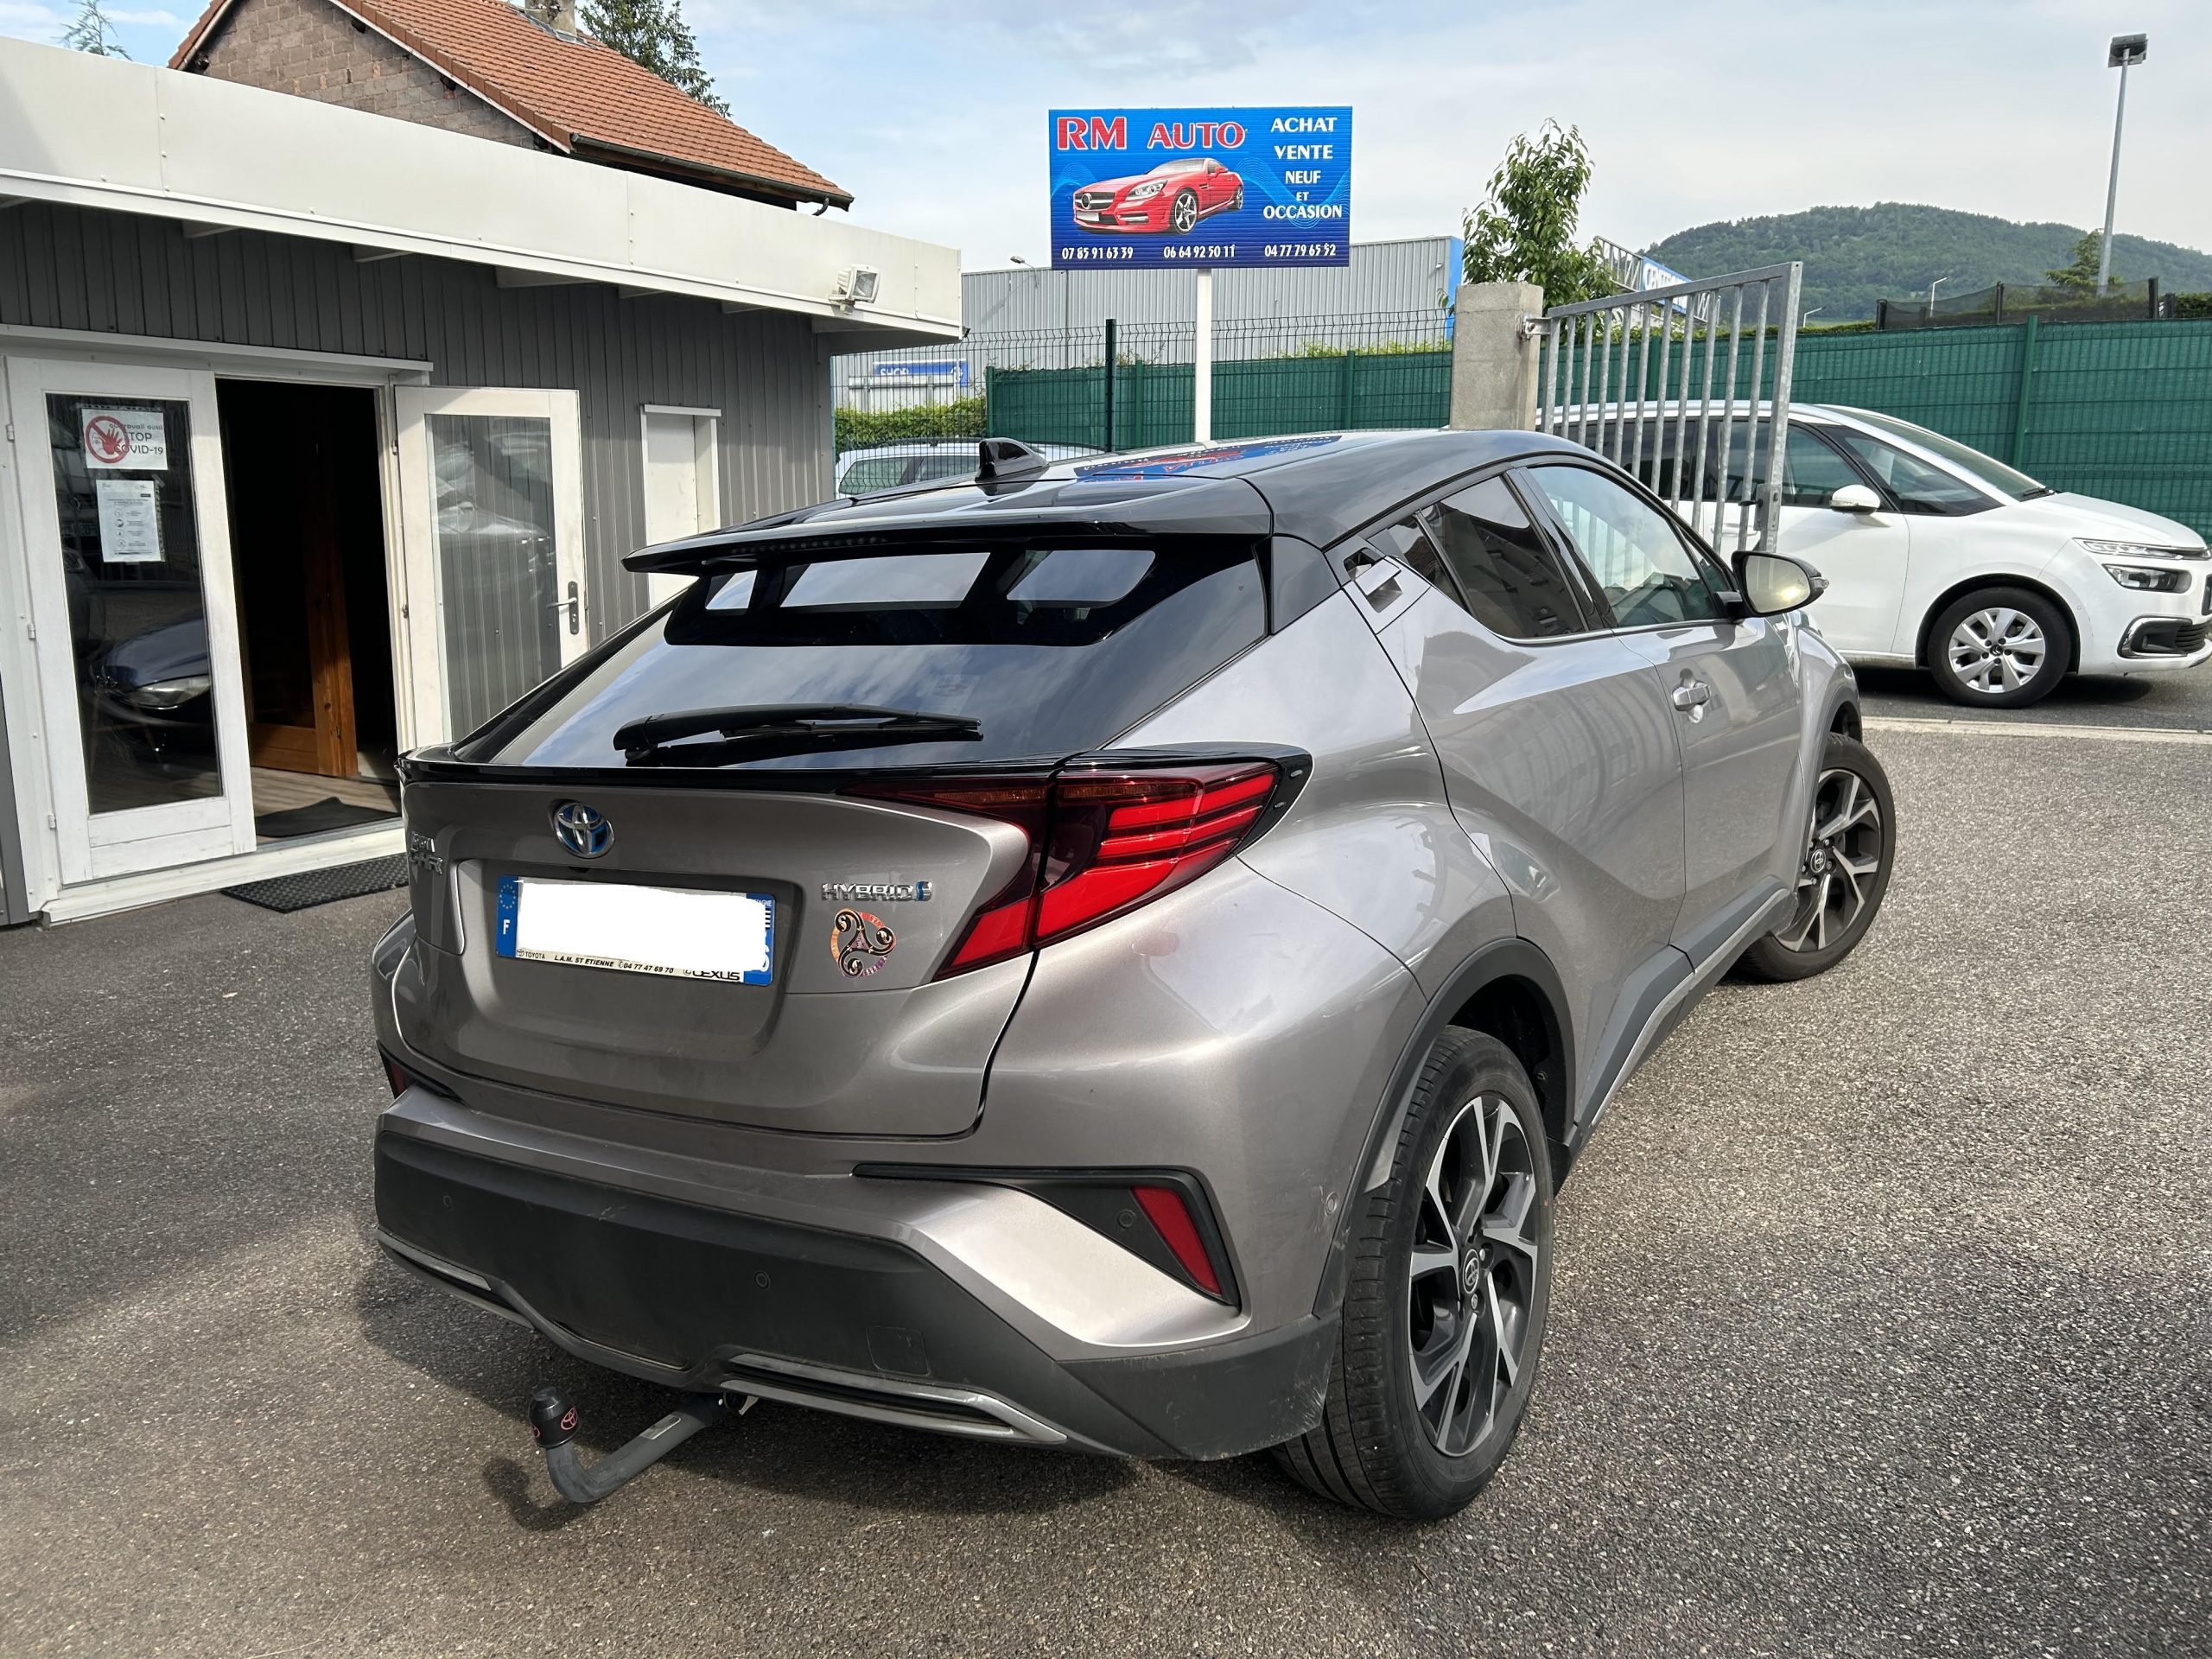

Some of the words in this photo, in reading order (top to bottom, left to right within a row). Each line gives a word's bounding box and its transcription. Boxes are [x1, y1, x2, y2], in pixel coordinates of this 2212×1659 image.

[1270, 117, 1338, 133] ACHAT
[1057, 116, 1127, 150] RM
[1147, 121, 1246, 149] AUTO
[1274, 144, 1333, 160] VENTE
[1285, 170, 1321, 184] NEUF
[1296, 191, 1310, 201] ET
[1262, 204, 1342, 219] OCCASION
[1062, 247, 1074, 259] 07
[1077, 246, 1089, 259] 85
[1091, 247, 1103, 259] 91
[1106, 246, 1118, 259] 63
[1121, 246, 1134, 259] 39
[1163, 246, 1176, 258] 06
[1178, 245, 1192, 258] 64
[1193, 245, 1205, 257] 92
[1208, 245, 1221, 257] 50
[1223, 245, 1236, 257] 11
[1264, 245, 1278, 257] 04
[1279, 245, 1293, 257] 77
[1294, 244, 1306, 257] 79
[1309, 244, 1321, 257] 65
[114, 443, 163, 454] COVID-19
[822, 883, 914, 902] HYBRID
[503, 918, 511, 935] F
[524, 951, 546, 960] TOYOTA
[585, 958, 615, 968] ETIENNE
